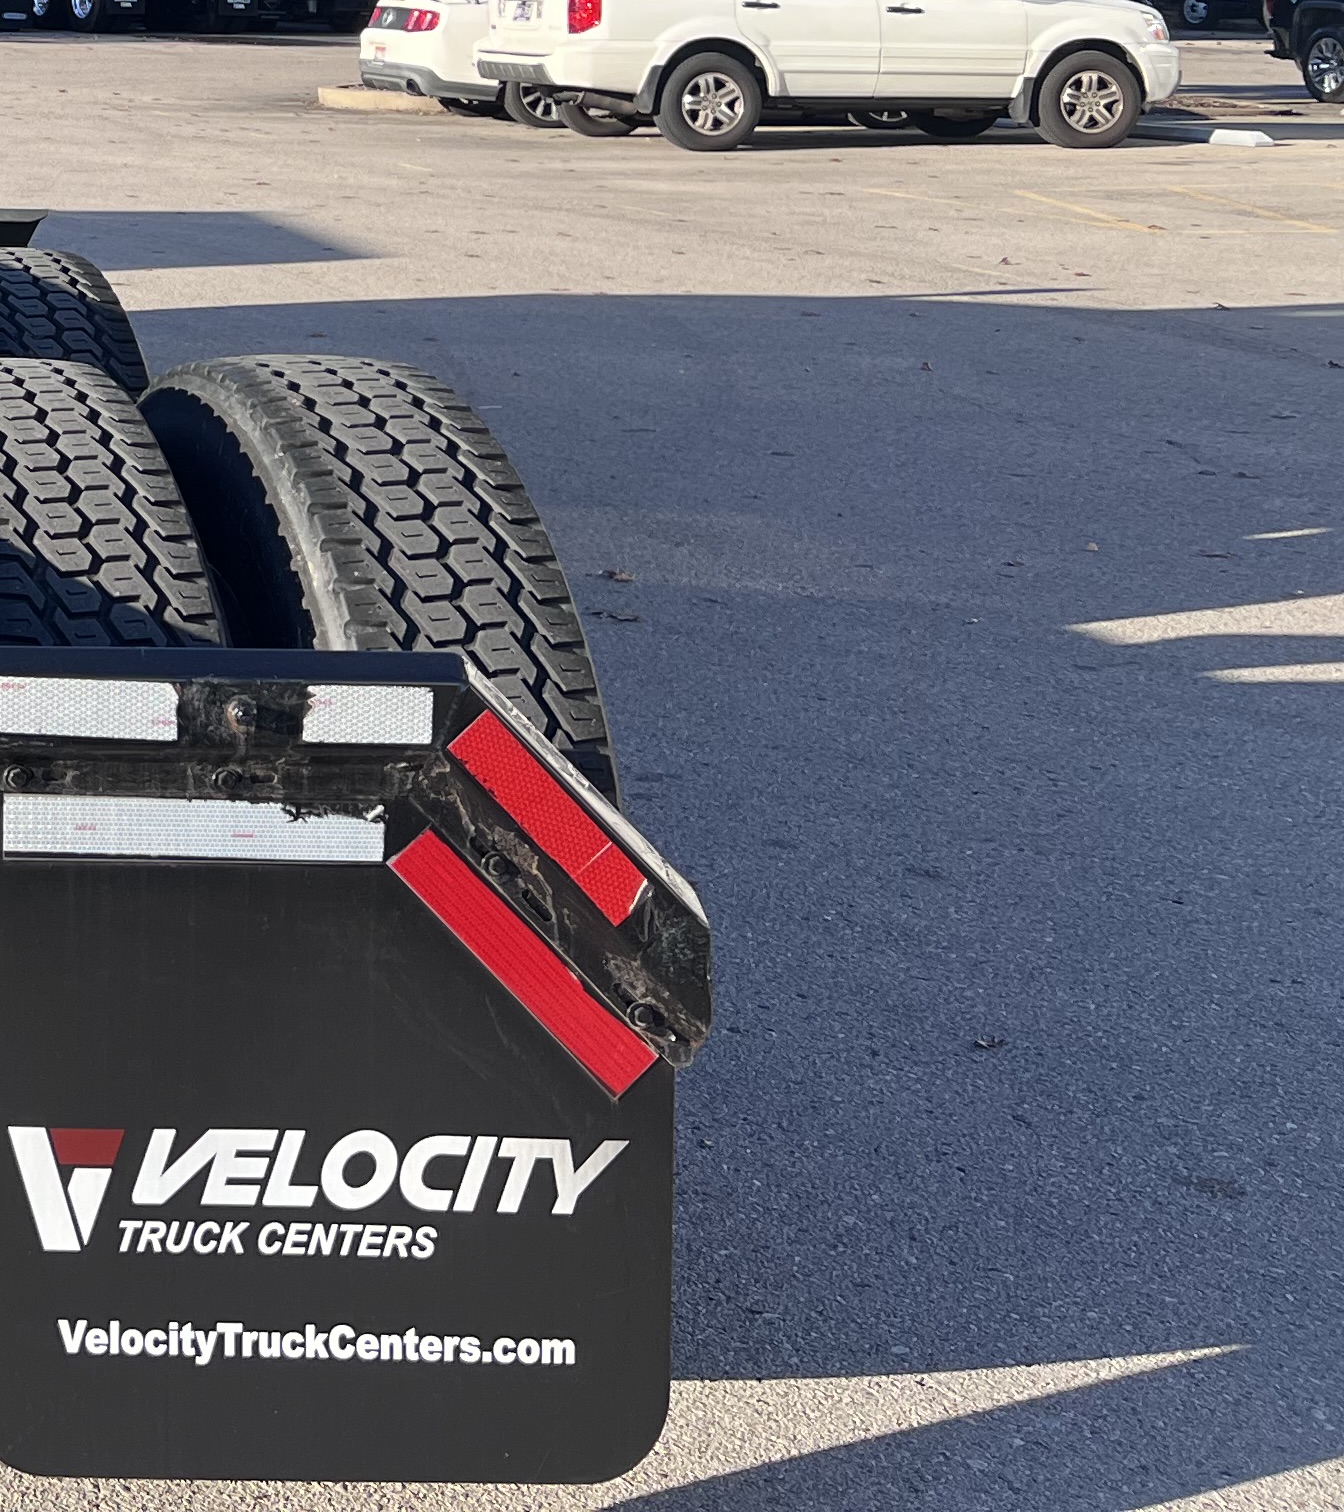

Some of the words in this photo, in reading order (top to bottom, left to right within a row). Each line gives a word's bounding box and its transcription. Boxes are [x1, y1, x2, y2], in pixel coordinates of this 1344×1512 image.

[131, 1128, 630, 1216] VELOCITY
[117, 1220, 244, 1256] TRUCK
[257, 1223, 438, 1260] CENTERS
[57, 1319, 577, 1366] VelocityTruckCenters.com
